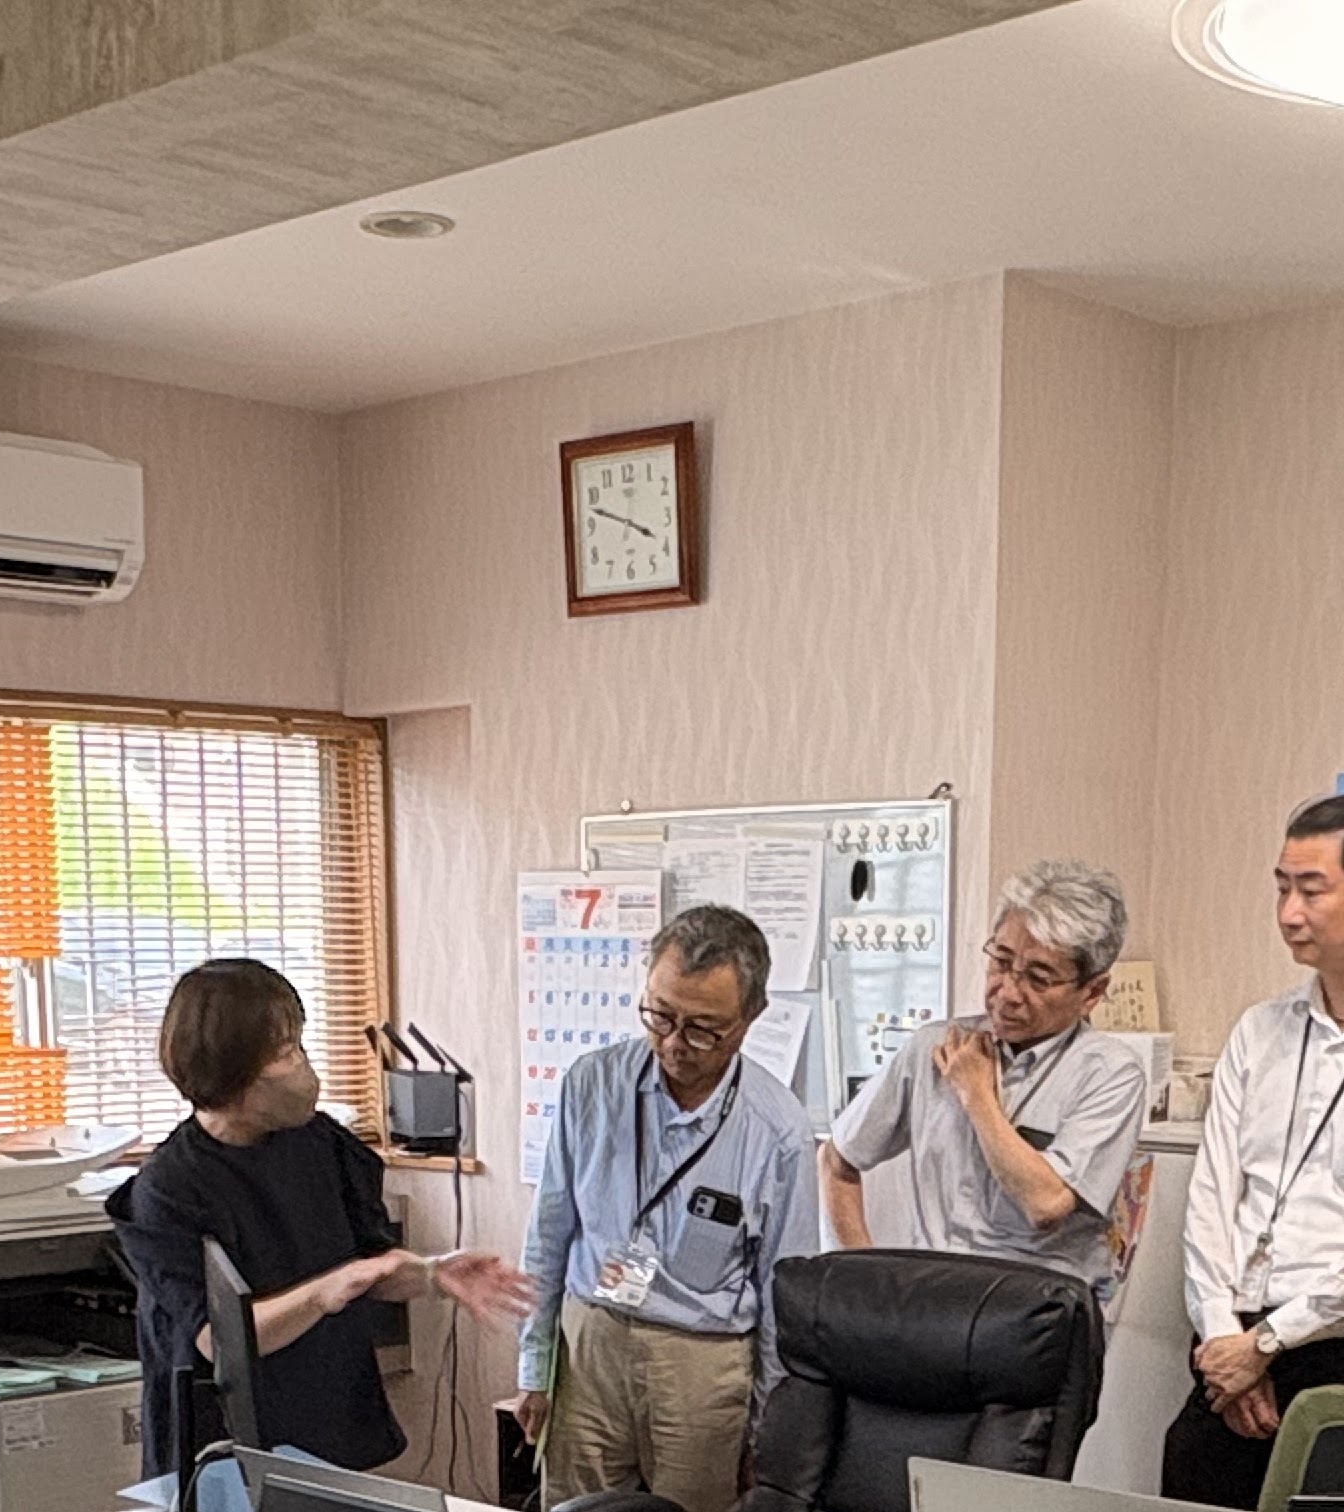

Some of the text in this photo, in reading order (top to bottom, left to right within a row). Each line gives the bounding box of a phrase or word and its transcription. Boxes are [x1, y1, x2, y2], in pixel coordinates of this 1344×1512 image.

[621, 463, 635, 483] 12
[646, 463, 654, 482] 1
[661, 476, 669, 496] 2
[664, 506, 672, 527] 3
[605, 560, 615, 579] 7
[626, 560, 635, 579] 6
[649, 554, 656, 575] 5
[574, 888, 602, 929] 7
